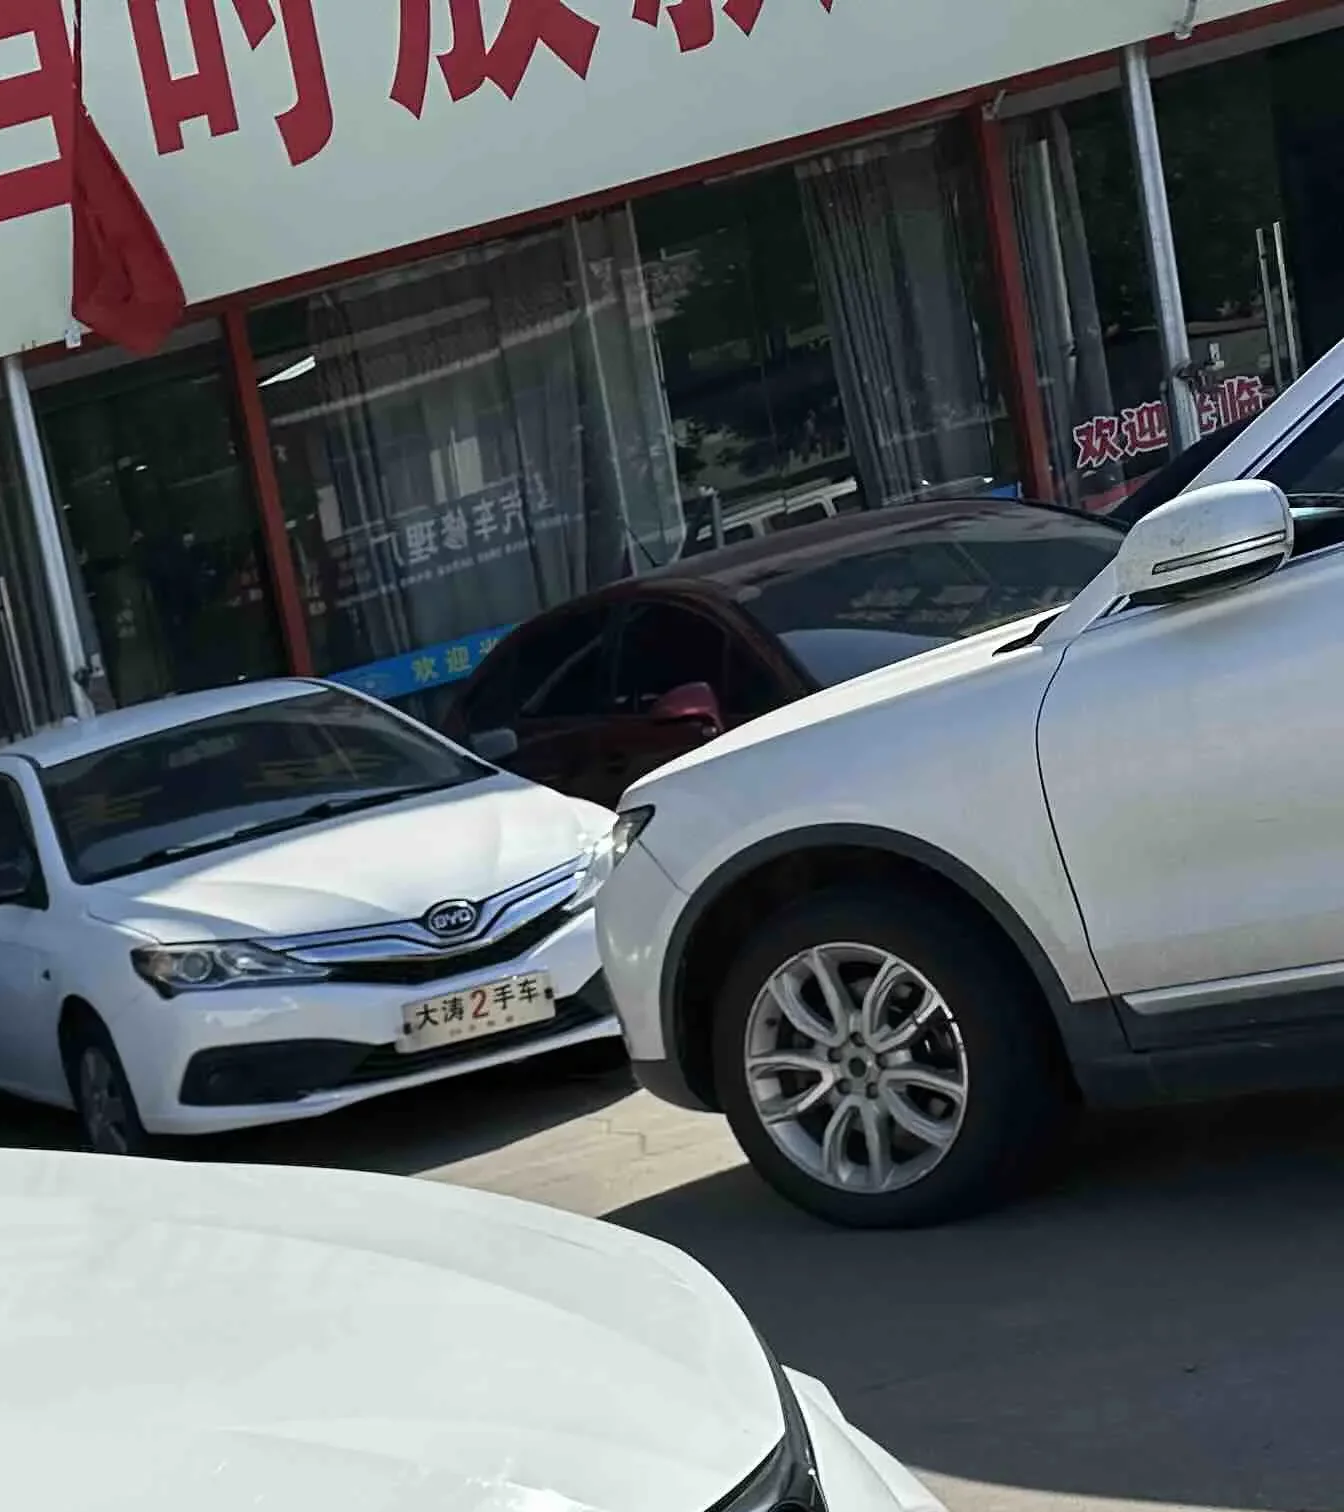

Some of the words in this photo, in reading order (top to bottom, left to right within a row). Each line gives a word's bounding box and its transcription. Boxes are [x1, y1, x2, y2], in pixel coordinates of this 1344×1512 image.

[433, 908, 472, 929] BYD
[415, 979, 540, 1030] 大涛2手车
